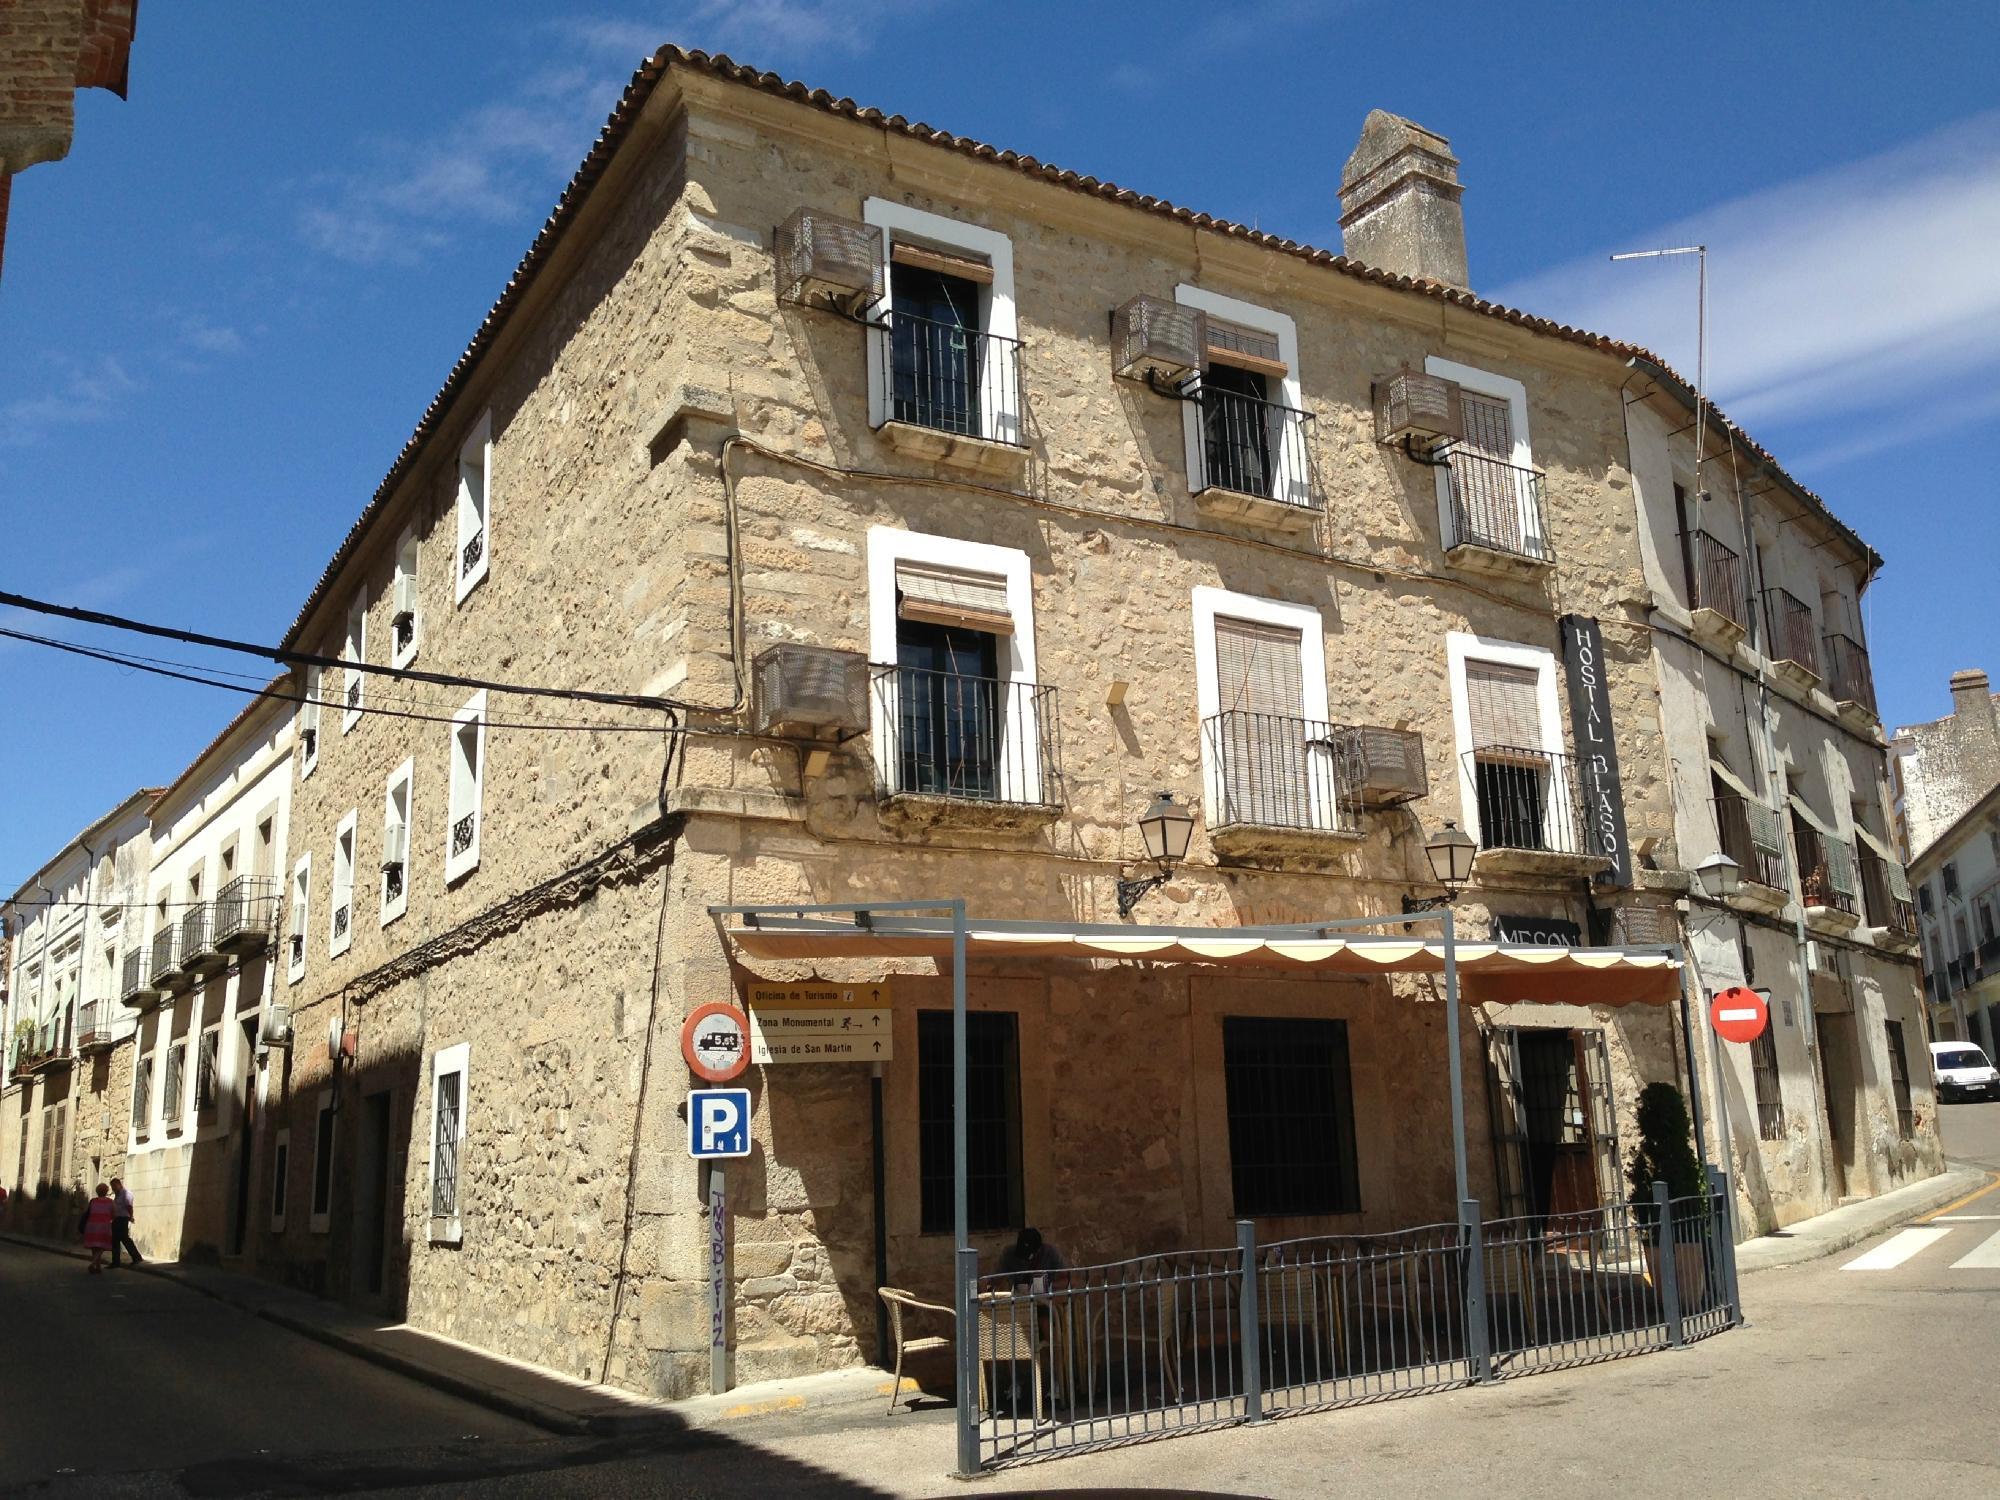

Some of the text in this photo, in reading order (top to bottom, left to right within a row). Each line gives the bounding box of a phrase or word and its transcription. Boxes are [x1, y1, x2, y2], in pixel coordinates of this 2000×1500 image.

[1576, 628, 1603, 742] HOSTAL
[755, 991, 786, 1001] Oficina
[790, 991, 800, 1000] de
[805, 990, 838, 1000] Turismo
[758, 1017, 834, 1027] Zona Monumental
[758, 1045, 787, 1056] Iglesia
[791, 1045, 801, 1054] de
[805, 1043, 820, 1054] San
[702, 1098, 738, 1150] P
